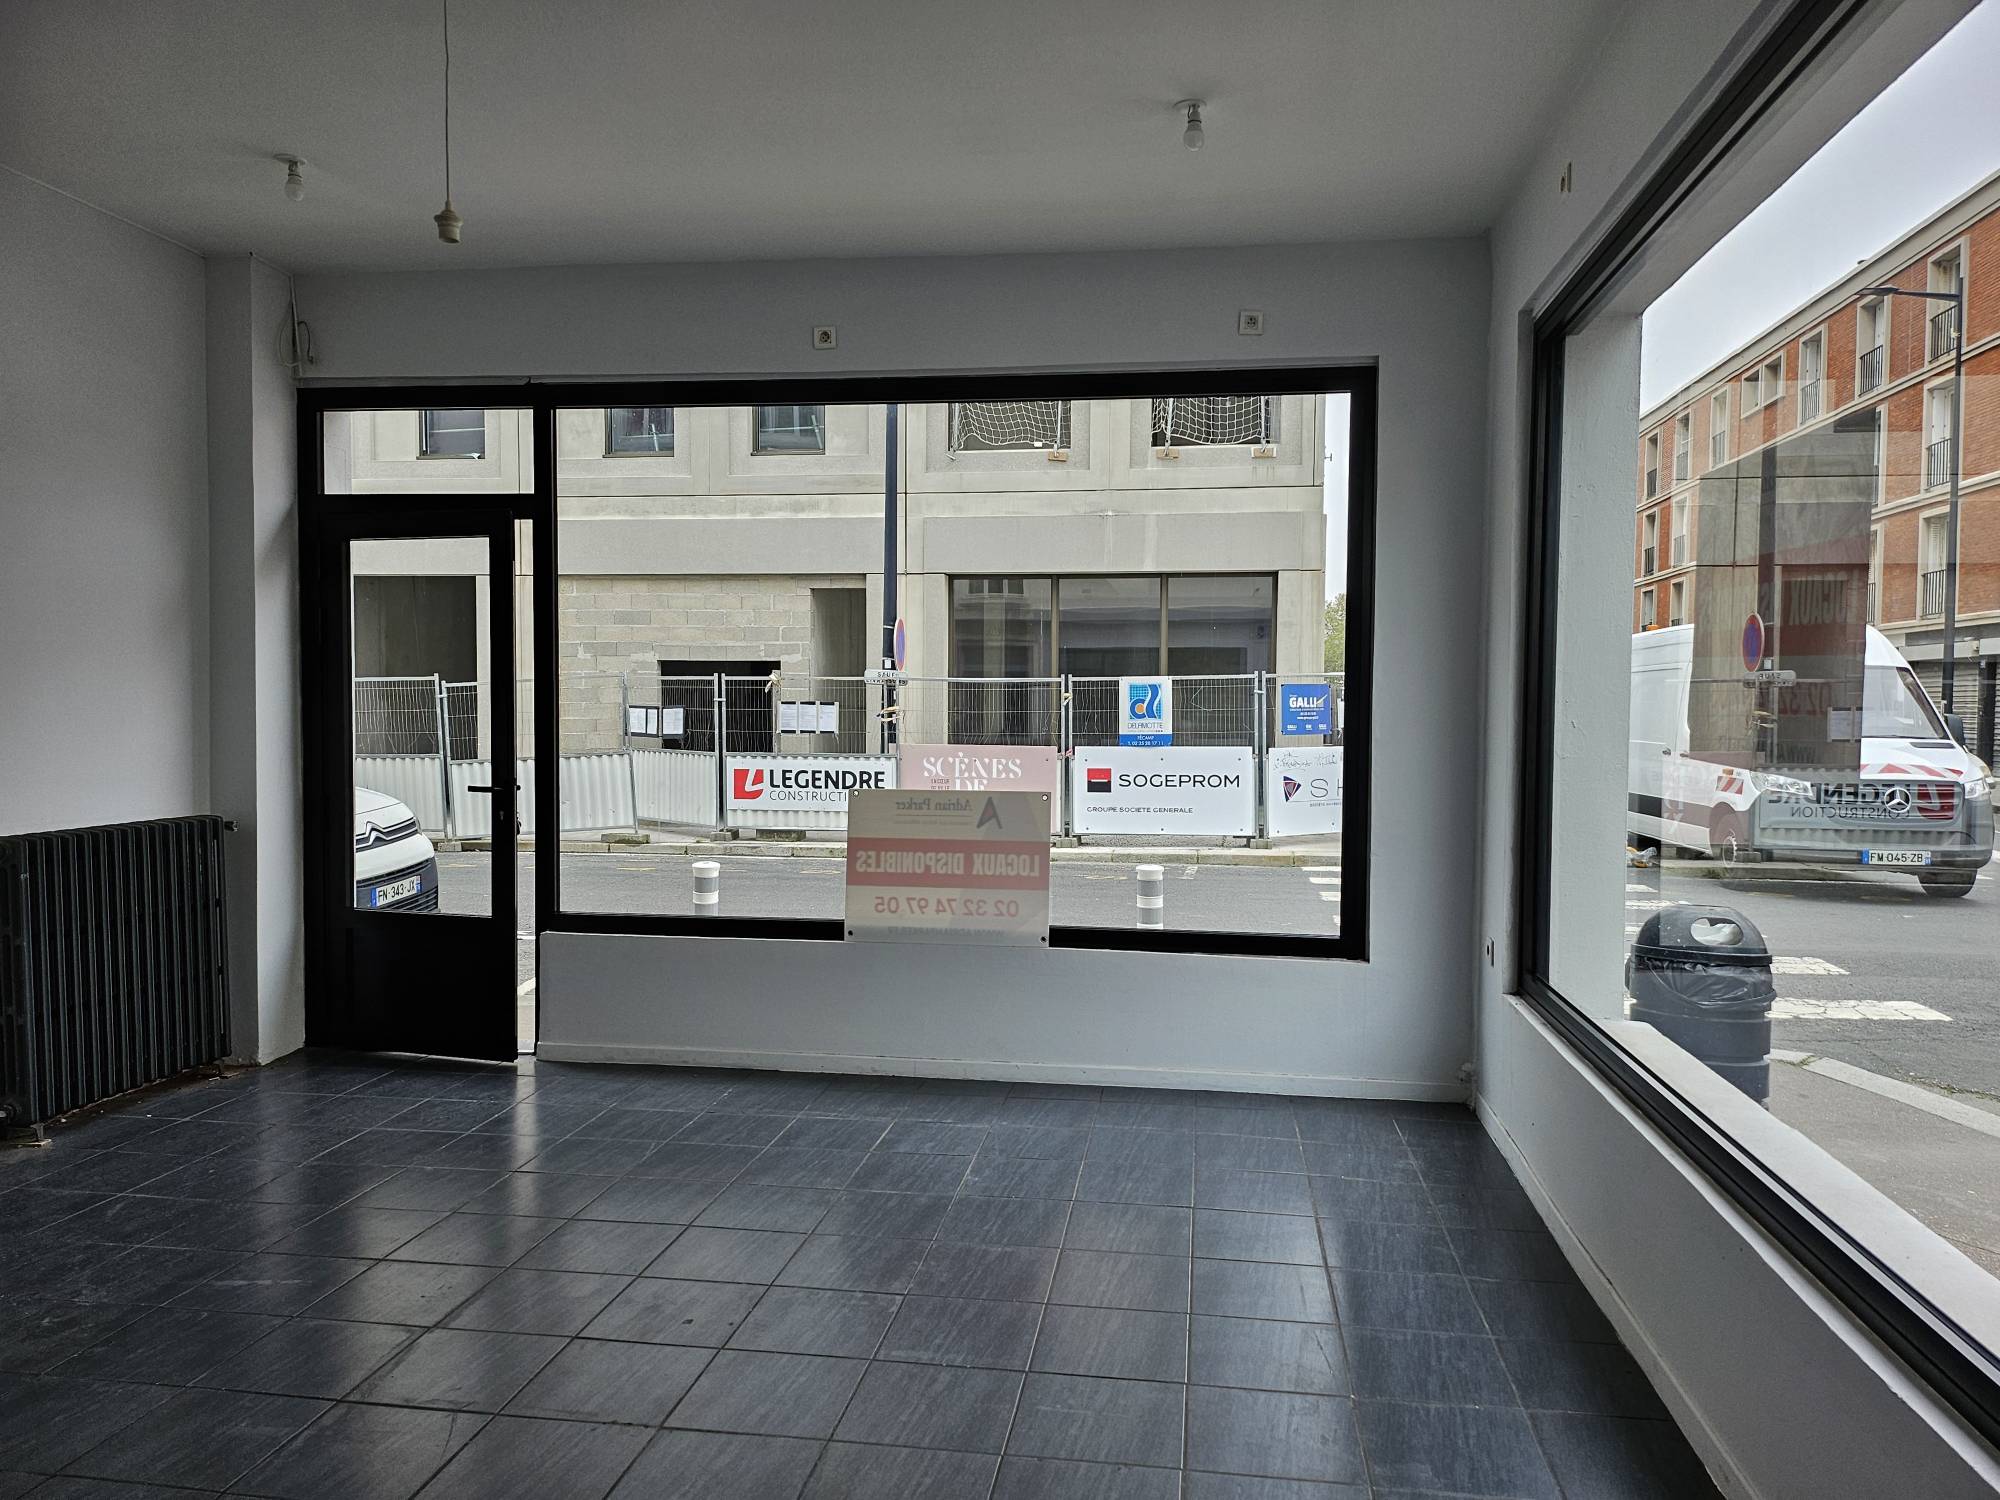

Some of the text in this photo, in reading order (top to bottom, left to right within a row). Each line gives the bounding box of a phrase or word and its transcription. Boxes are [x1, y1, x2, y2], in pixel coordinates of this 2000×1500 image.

[923, 752, 1022, 779] SCÈNES
[769, 769, 886, 789] LEGENDRE
[1118, 774, 1240, 788] SOGEPROM
[769, 790, 847, 802] CONSTRUCTI
